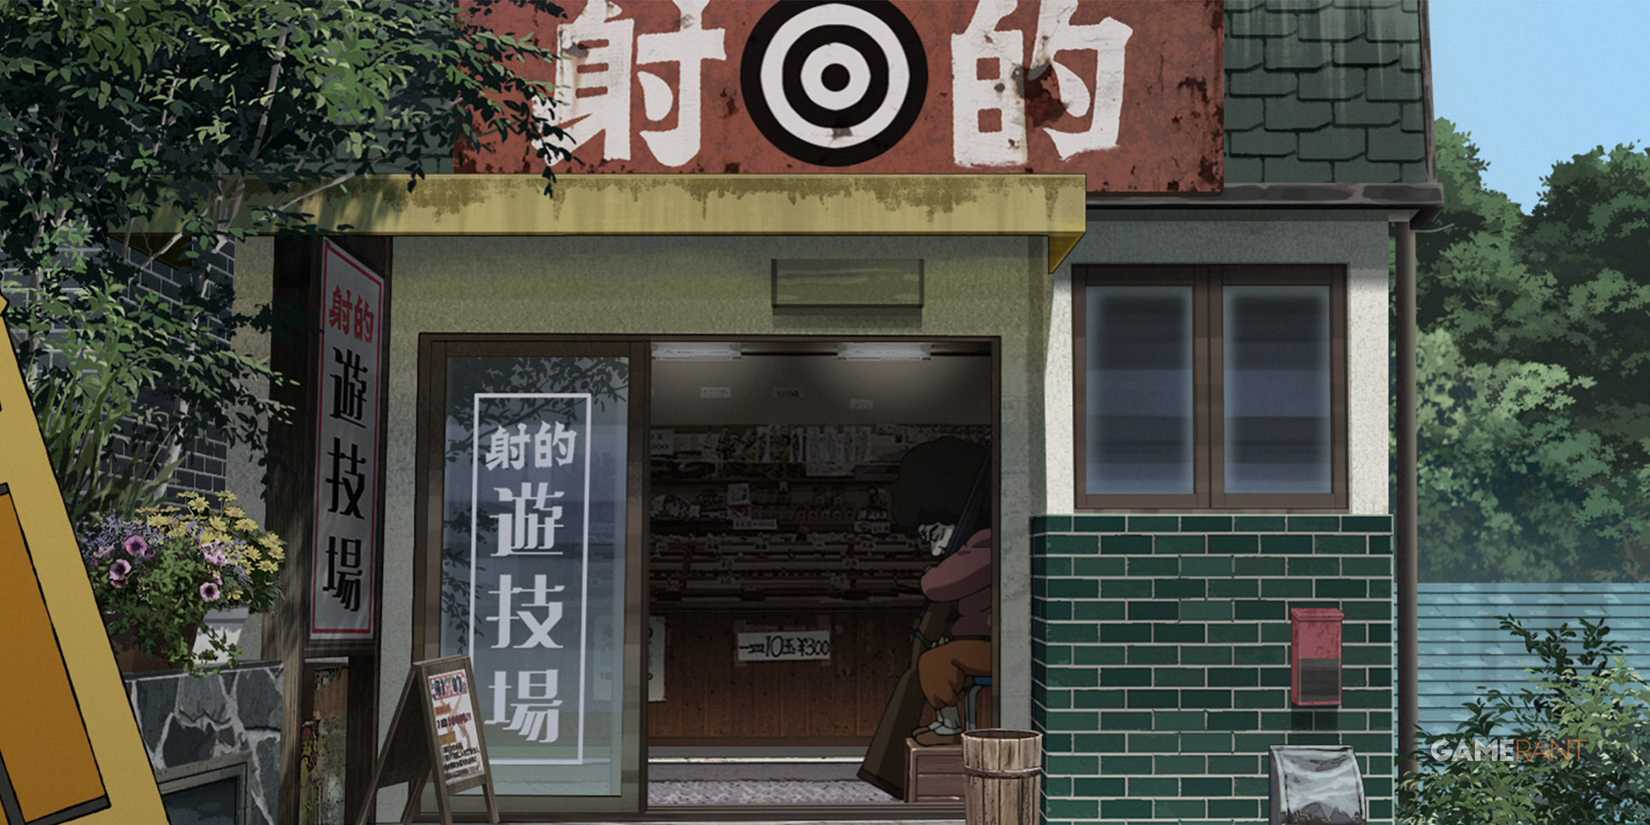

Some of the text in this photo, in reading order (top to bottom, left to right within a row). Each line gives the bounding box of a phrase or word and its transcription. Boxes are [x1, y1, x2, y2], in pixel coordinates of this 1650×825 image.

[329, 288, 374, 343] 射的
[322, 345, 368, 613] 遊技場
[485, 421, 577, 471] 射的
[484, 482, 565, 743] 遊技場
